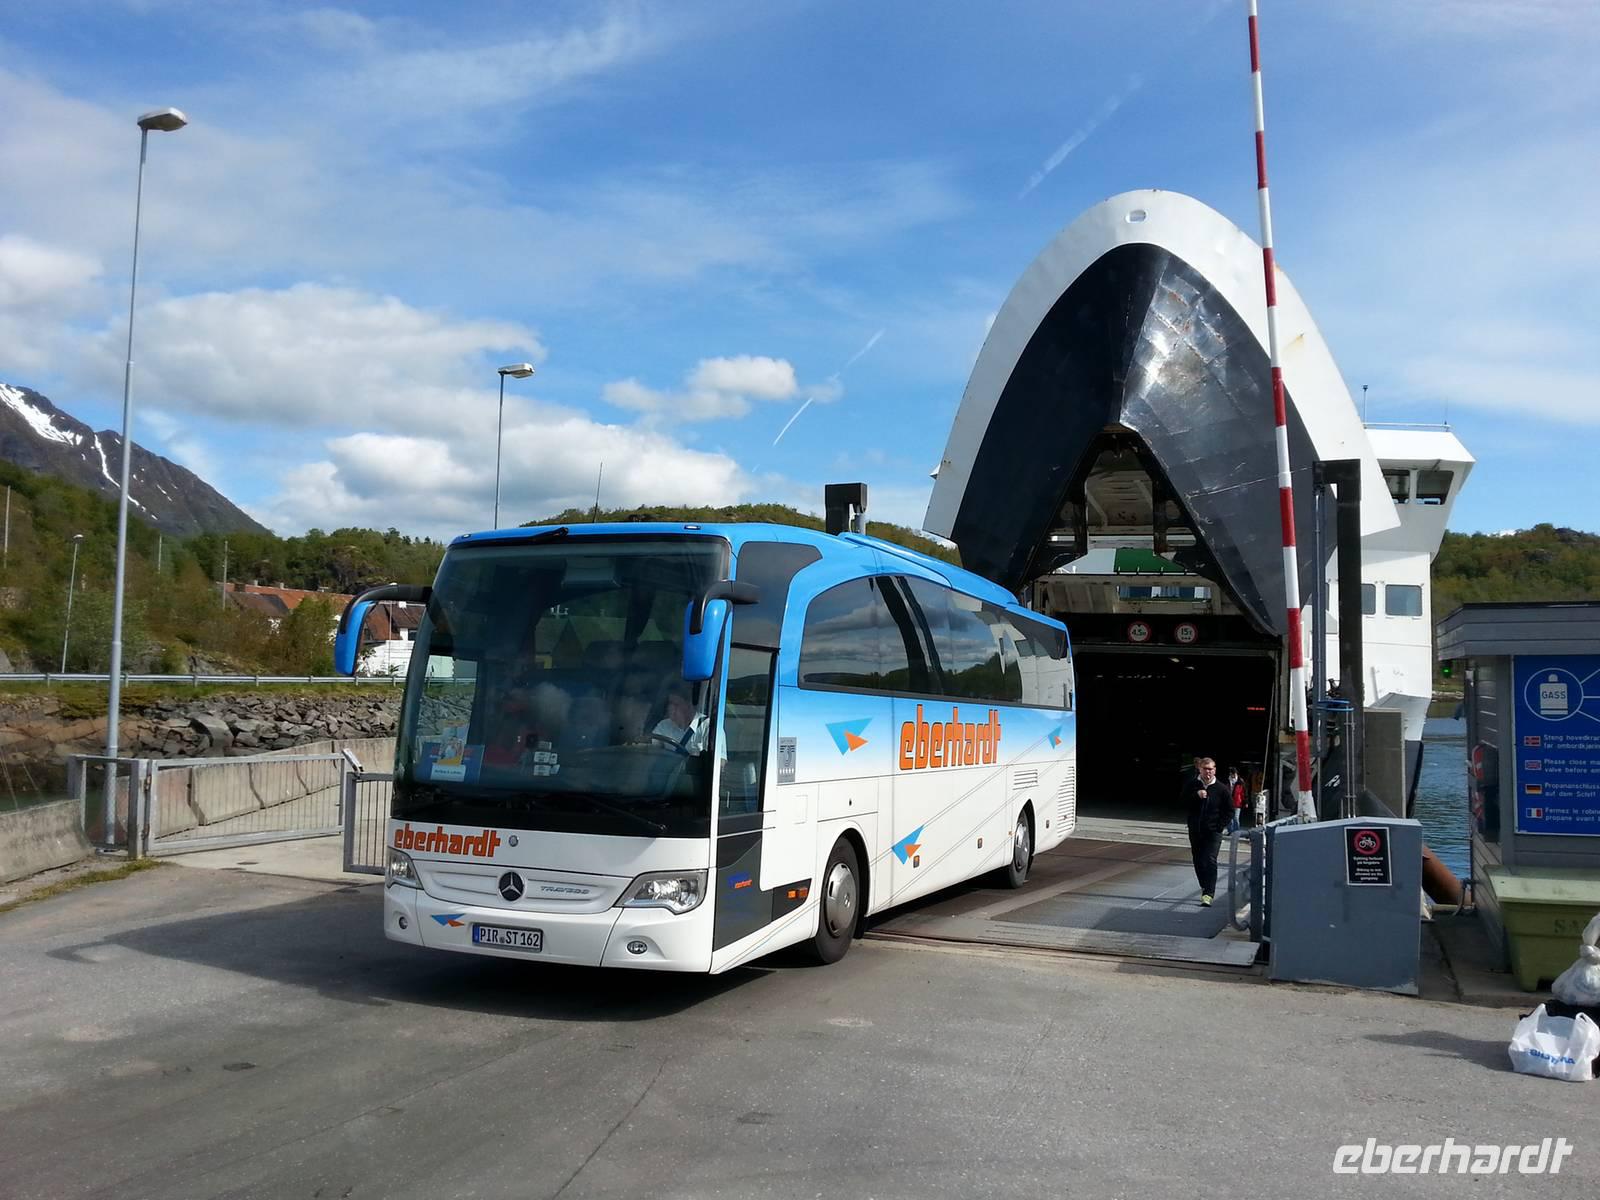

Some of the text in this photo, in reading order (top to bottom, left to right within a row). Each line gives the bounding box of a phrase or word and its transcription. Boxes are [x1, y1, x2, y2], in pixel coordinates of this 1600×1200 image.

[1542, 690, 1566, 700] GASS
[899, 704, 1002, 771] eberhardt
[1543, 758, 1566, 766] Please
[394, 824, 501, 857] eberhardt
[480, 928, 540, 947] PIR ST 162
